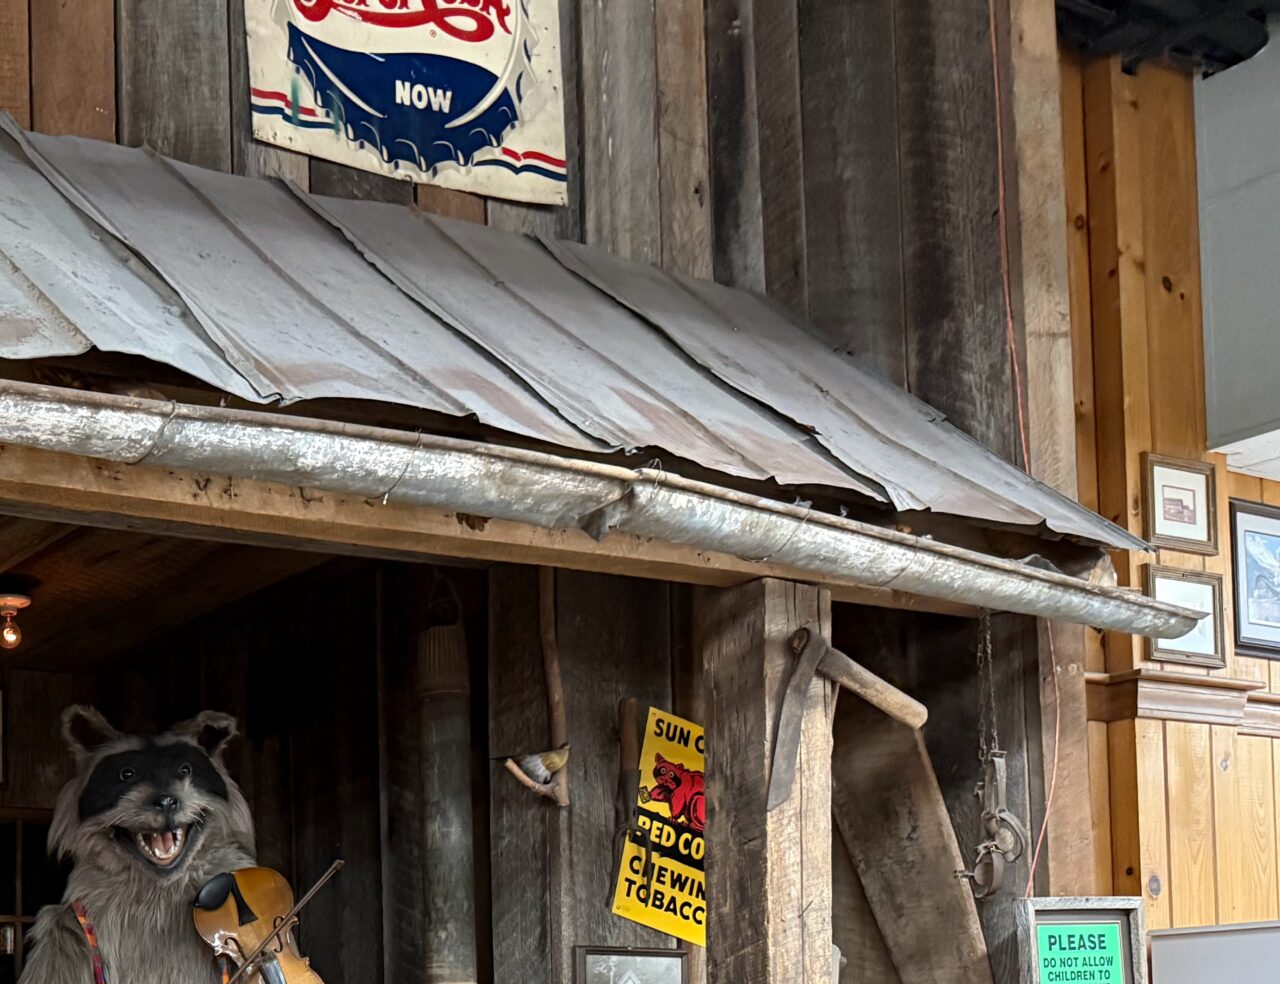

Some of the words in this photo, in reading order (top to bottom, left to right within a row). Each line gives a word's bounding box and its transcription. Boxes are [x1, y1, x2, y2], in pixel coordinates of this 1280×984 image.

[394, 79, 453, 114] NOW
[653, 717, 691, 748] SUN
[624, 877, 705, 925] TOBACC
[1047, 933, 1107, 951] PLEASE
[1043, 957, 1057, 968] DO
[1059, 957, 1079, 968] NOT
[1081, 955, 1114, 967] ALLOW
[1047, 970, 1095, 982] CHILDREN
[1098, 969, 1111, 980] TO
